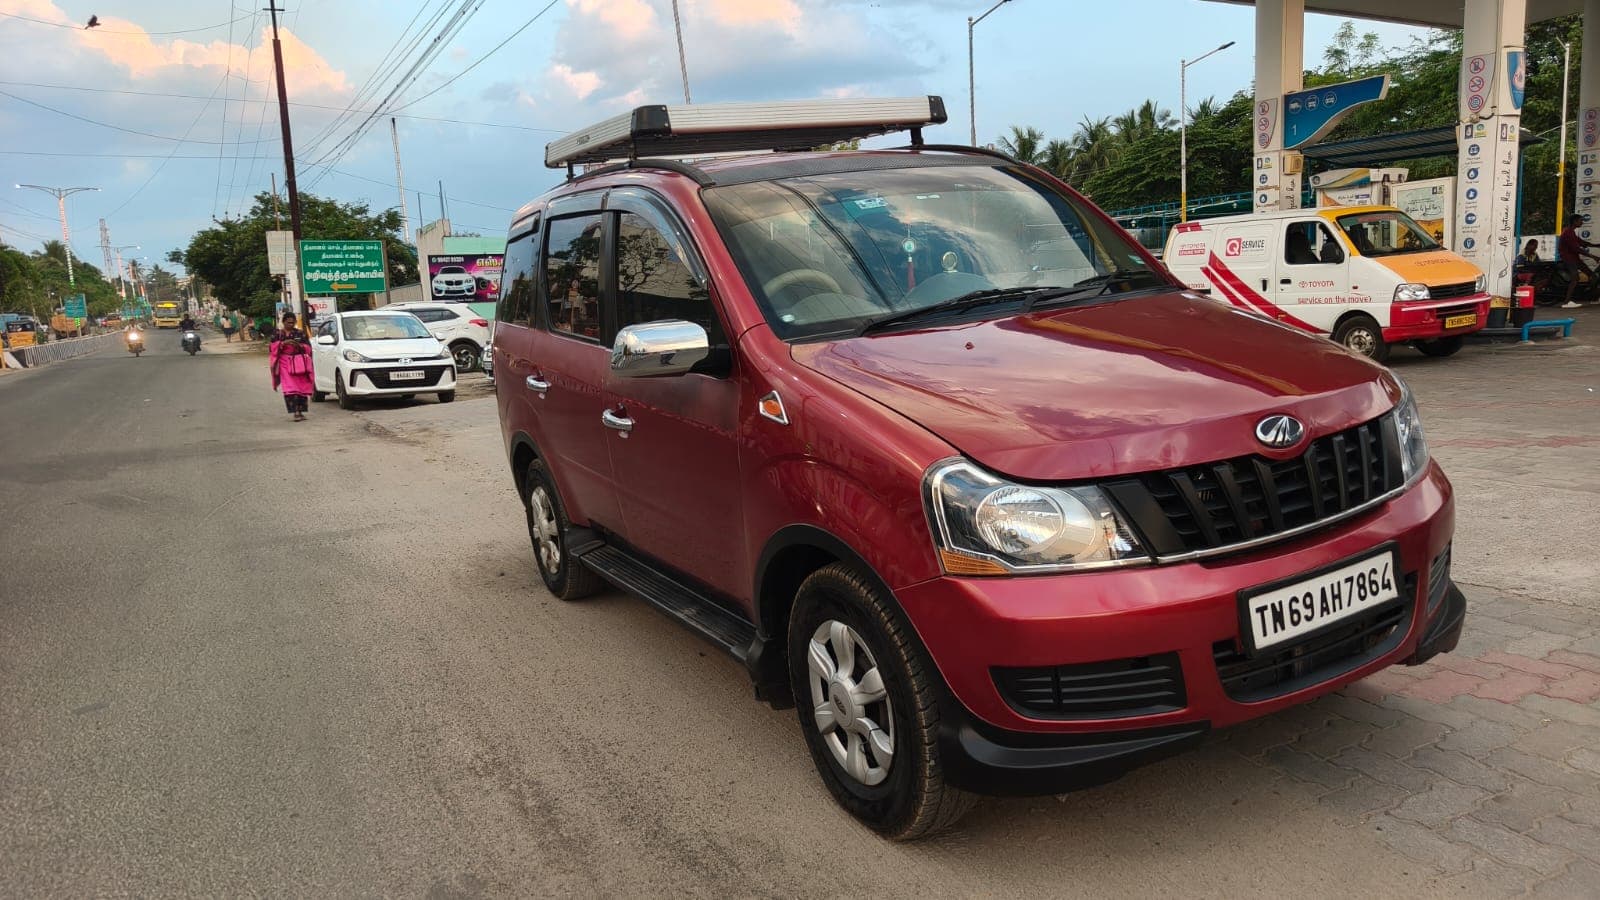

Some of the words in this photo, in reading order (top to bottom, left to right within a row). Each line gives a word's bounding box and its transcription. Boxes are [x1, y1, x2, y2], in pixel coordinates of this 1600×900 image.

[1241, 239, 1265, 249] SERVICE
[1309, 280, 1335, 288] TOYOTA
[1297, 296, 1322, 304] service
[1335, 295, 1346, 304] the
[1255, 563, 1392, 637] TN69AH7864
